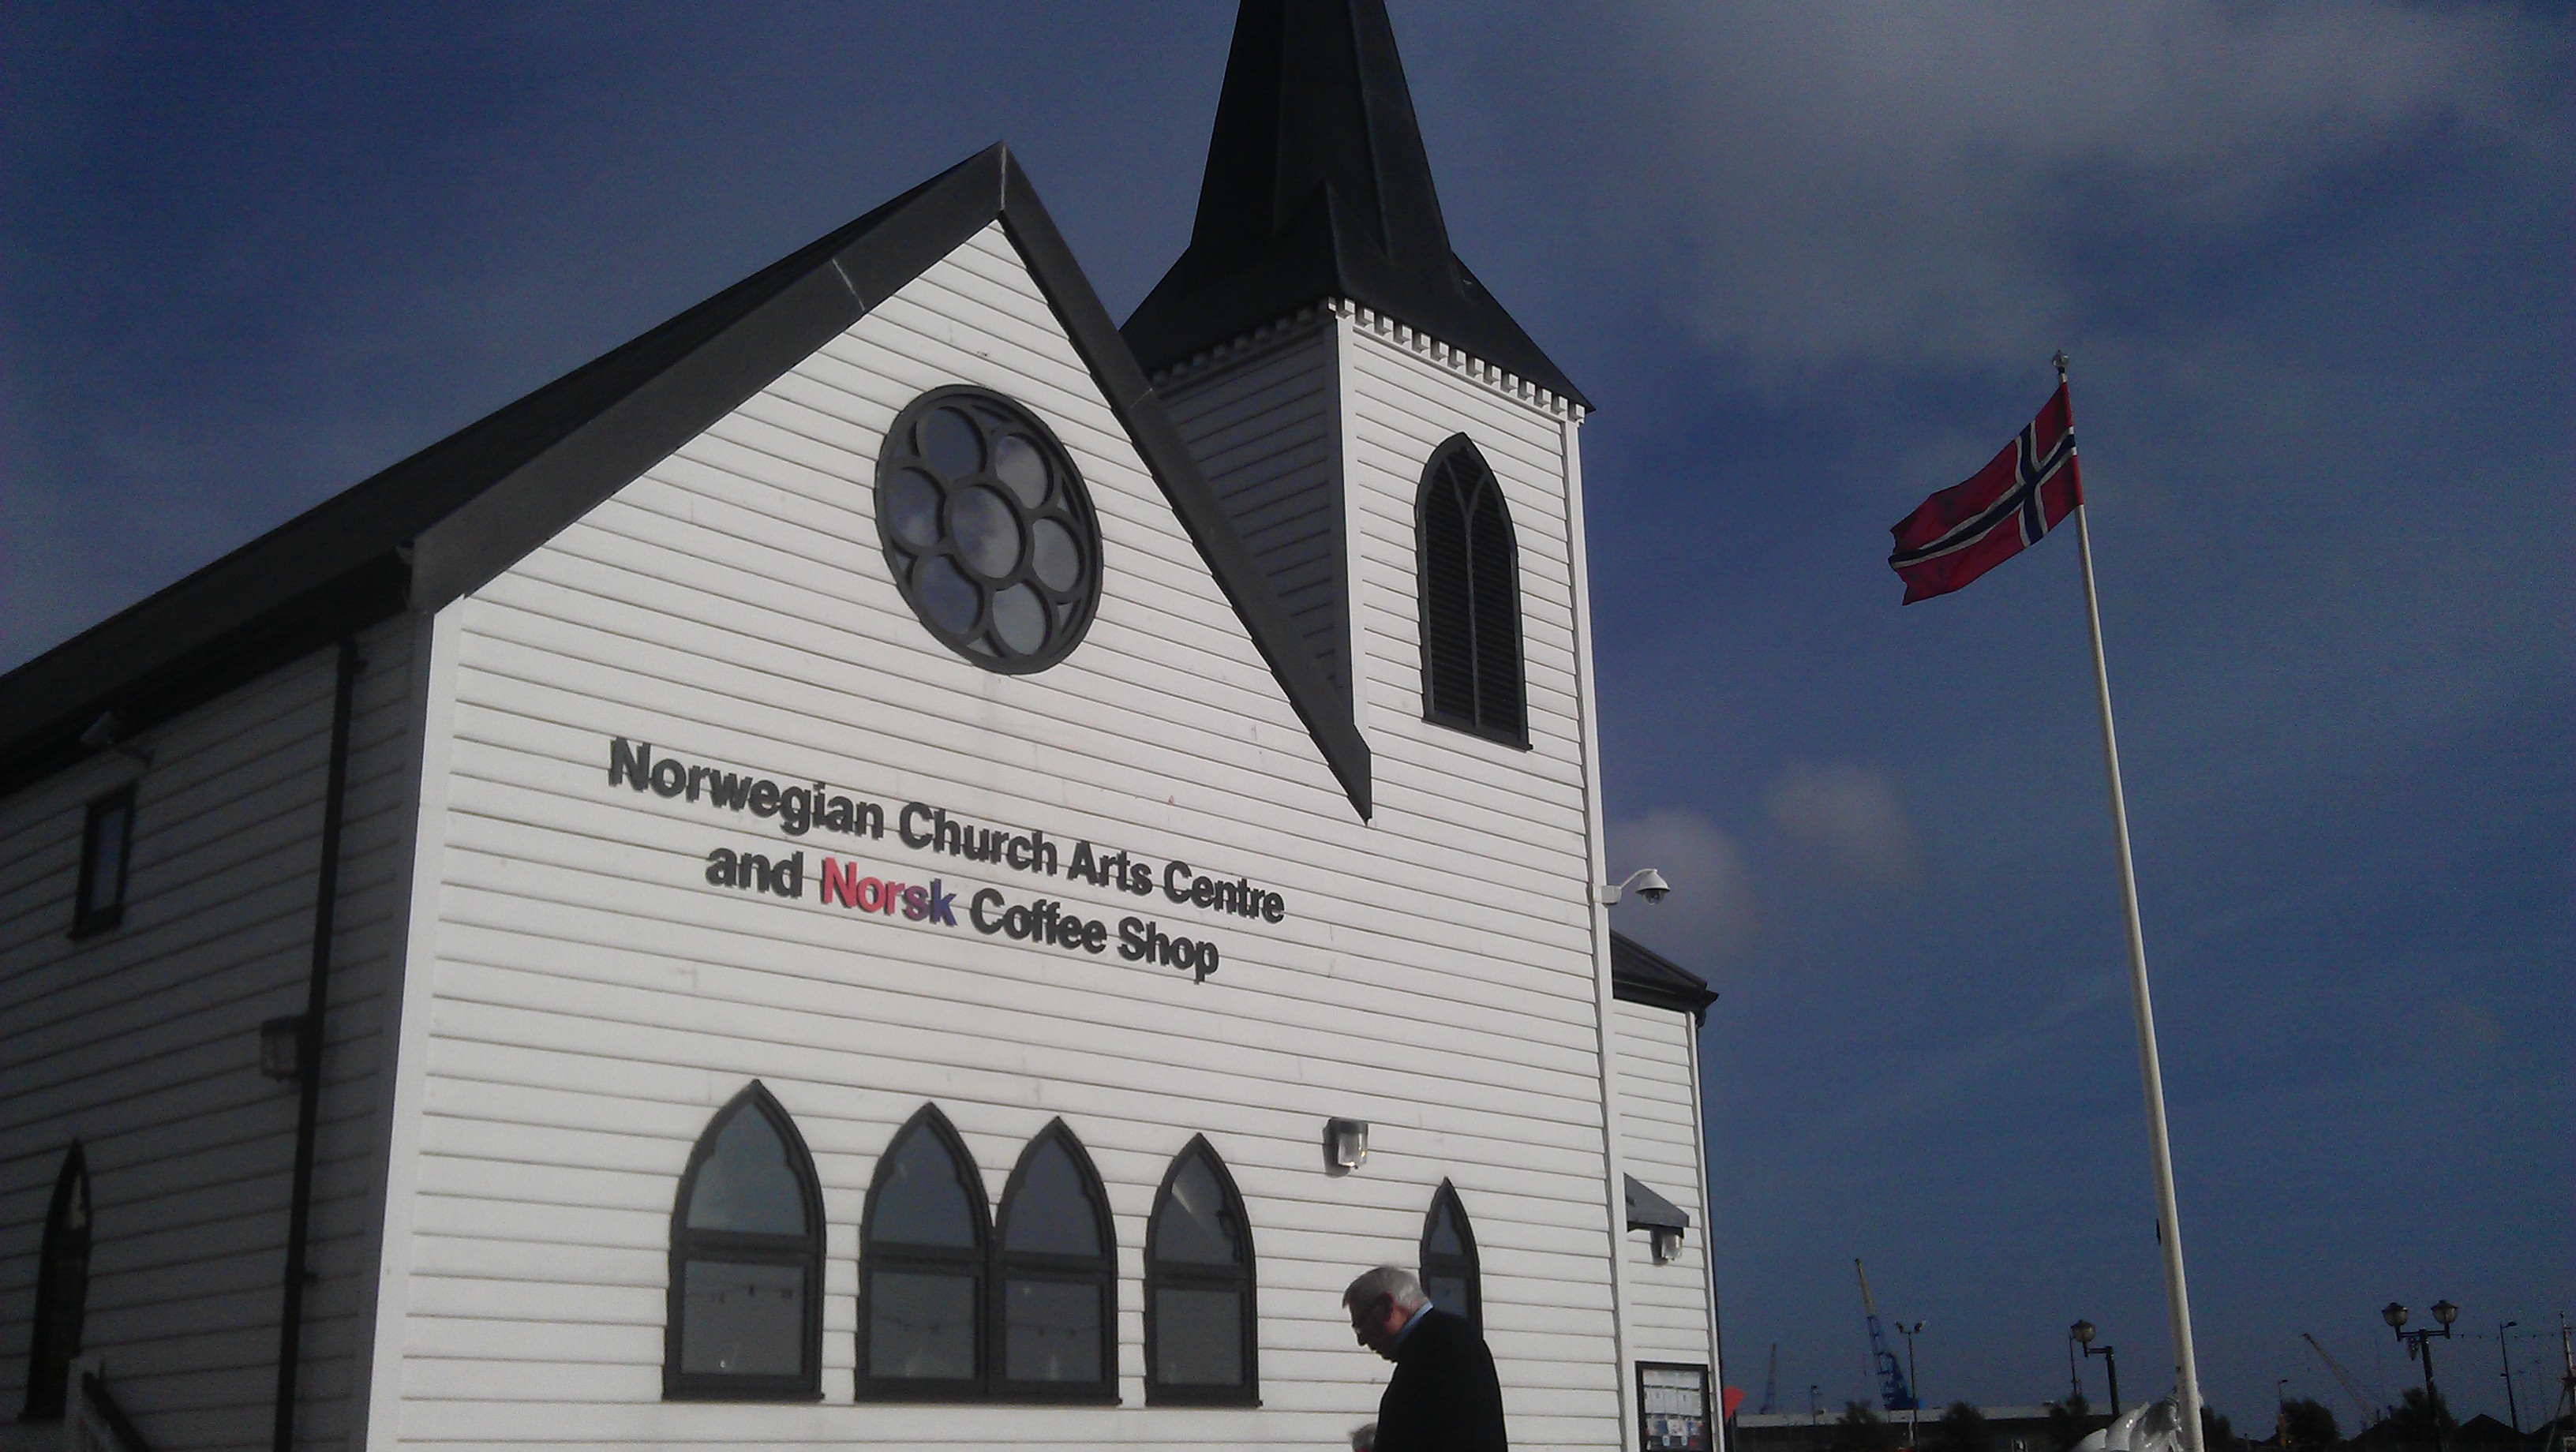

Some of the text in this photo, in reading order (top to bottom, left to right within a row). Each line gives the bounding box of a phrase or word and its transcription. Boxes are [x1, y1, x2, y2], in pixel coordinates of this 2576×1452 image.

[607, 736, 1285, 924] Norwegian Church Arts Centre
[706, 848, 1219, 984] and Norsk Coffee Shop
